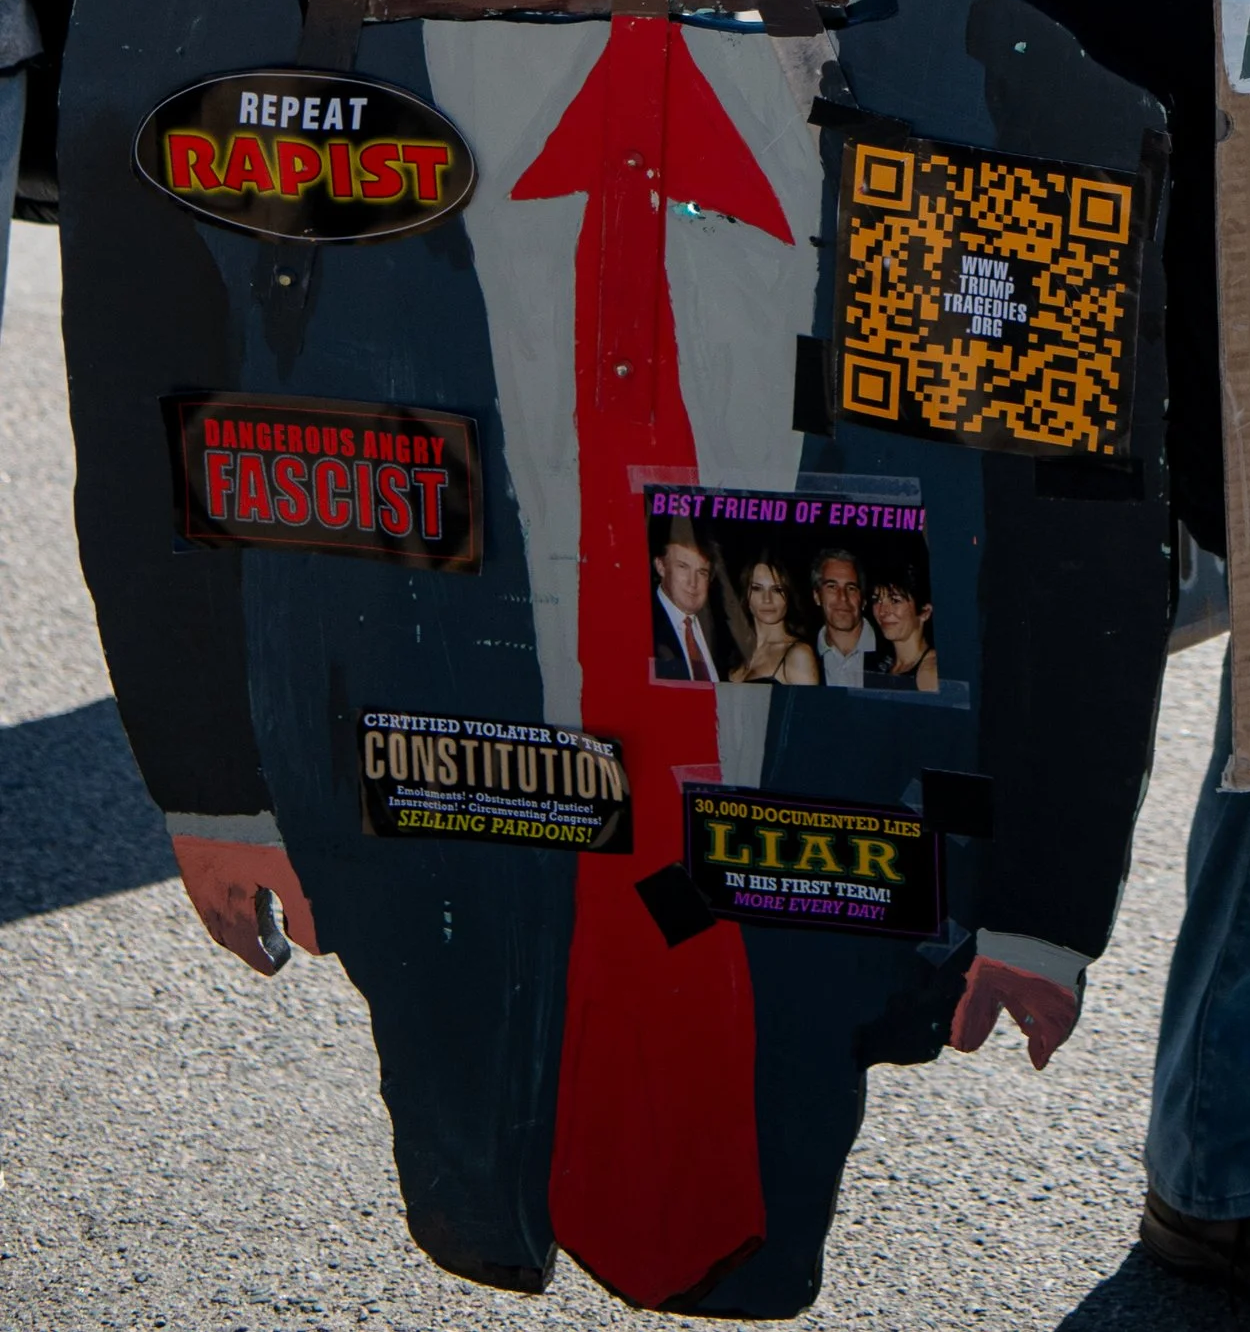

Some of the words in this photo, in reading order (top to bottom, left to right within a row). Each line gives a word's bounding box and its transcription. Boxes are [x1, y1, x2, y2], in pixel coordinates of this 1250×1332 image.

[240, 91, 368, 130] REPEAT
[167, 133, 449, 202] RAPIST
[962, 255, 1014, 282] WWW.
[959, 275, 1015, 300] TRUMP
[943, 293, 1028, 323] TRAGEDIES
[966, 316, 1003, 338] .ORG
[204, 418, 356, 457] DANGEROUS
[363, 430, 445, 465] ANGRY
[204, 450, 448, 540] FASCIST
[652, 493, 706, 518] BEST
[711, 496, 787, 523] FRIEND
[795, 502, 822, 525] OF
[829, 503, 926, 531] EPSTEIN!
[363, 713, 460, 734] CERTIFIED
[463, 721, 552, 743] VIOLATER
[556, 731, 578, 746] OF
[582, 737, 614, 757] THE
[364, 730, 623, 802] CONSTITUTION
[388, 796, 458, 812] Insurrection!
[468, 803, 546, 822] Circumventing
[549, 812, 602, 826] Congress!
[396, 785, 467, 801] Emoluments!
[475, 792, 538, 809] Obstruction
[540, 800, 551, 810] of
[552, 801, 594, 814] Justice!
[398, 809, 486, 834] SELLING
[490, 818, 593, 844] PARDONS!
[694, 798, 748, 818] 30,000
[751, 805, 880, 832] DOCUMENTED
[883, 819, 922, 838] LIES
[706, 820, 903, 883] LIAR
[725, 871, 746, 888] IN
[749, 874, 778, 892] HIS
[780, 878, 832, 896] FIRST
[834, 883, 891, 903] TERM!
[734, 891, 785, 911] MORE
[788, 897, 845, 915] EVERY
[847, 902, 886, 921] DAY!
